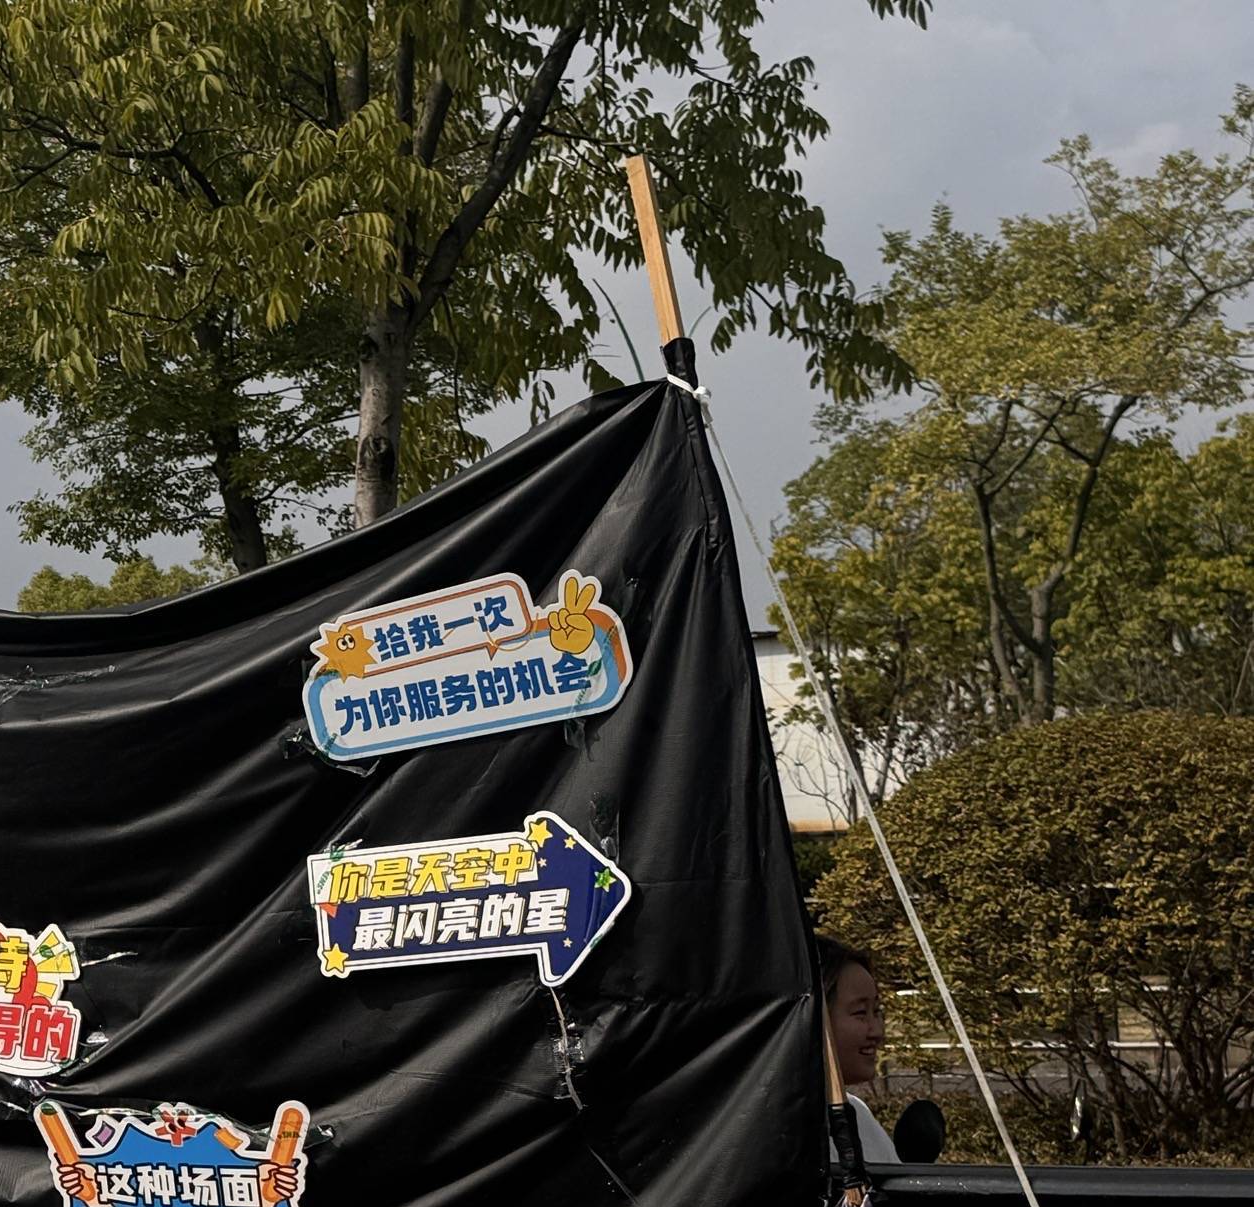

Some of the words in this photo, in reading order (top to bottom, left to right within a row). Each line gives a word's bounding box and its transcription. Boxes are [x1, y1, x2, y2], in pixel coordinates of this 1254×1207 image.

[374, 597, 514, 661] 给我一次
[335, 654, 592, 736] 为你服务的机会
[329, 844, 536, 904] 你是天空中
[351, 888, 570, 951] 最闪亮的星
[96, 1163, 261, 1207] 这种场面
